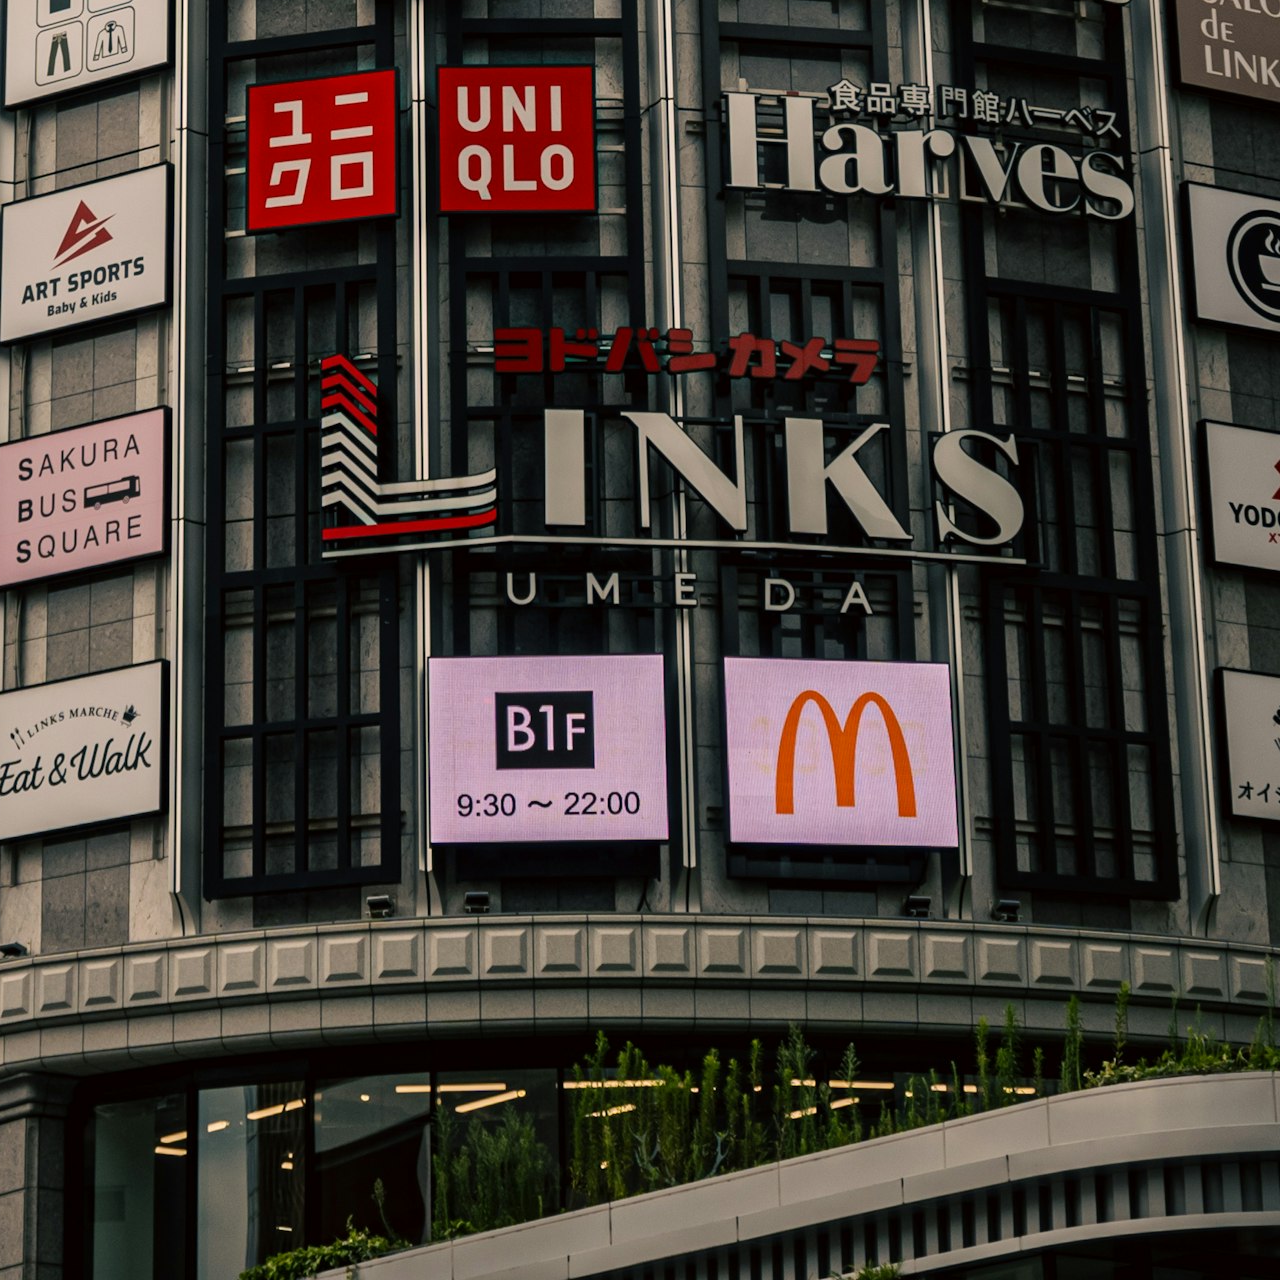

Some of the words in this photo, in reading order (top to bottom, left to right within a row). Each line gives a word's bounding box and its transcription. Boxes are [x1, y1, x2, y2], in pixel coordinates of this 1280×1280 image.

[269, 91, 373, 147] ユニ
[457, 85, 562, 132] UNI
[829, 79, 1122, 138] 食品専門館ハーベス
[265, 151, 373, 208] クロ
[458, 144, 574, 200] QLO
[723, 92, 1136, 220] Harves
[21, 277, 61, 304] ART
[67, 256, 145, 293] SPORTS
[47, 301, 76, 316] Baby
[79, 296, 88, 308] &
[91, 290, 117, 306] Kids
[18, 434, 140, 481] SAKURA
[18, 489, 76, 523] BUS
[16, 514, 142, 563] SQUARE
[506, 572, 873, 614] UMEDA
[26, 711, 65, 739] LINKS
[69, 706, 119, 721] MARCHE
[506, 705, 586, 752] B1F
[48, 752, 67, 786] &
[70, 731, 152, 782] Walk
[457, 792, 517, 817] 9:30
[563, 791, 641, 817] 22:00
